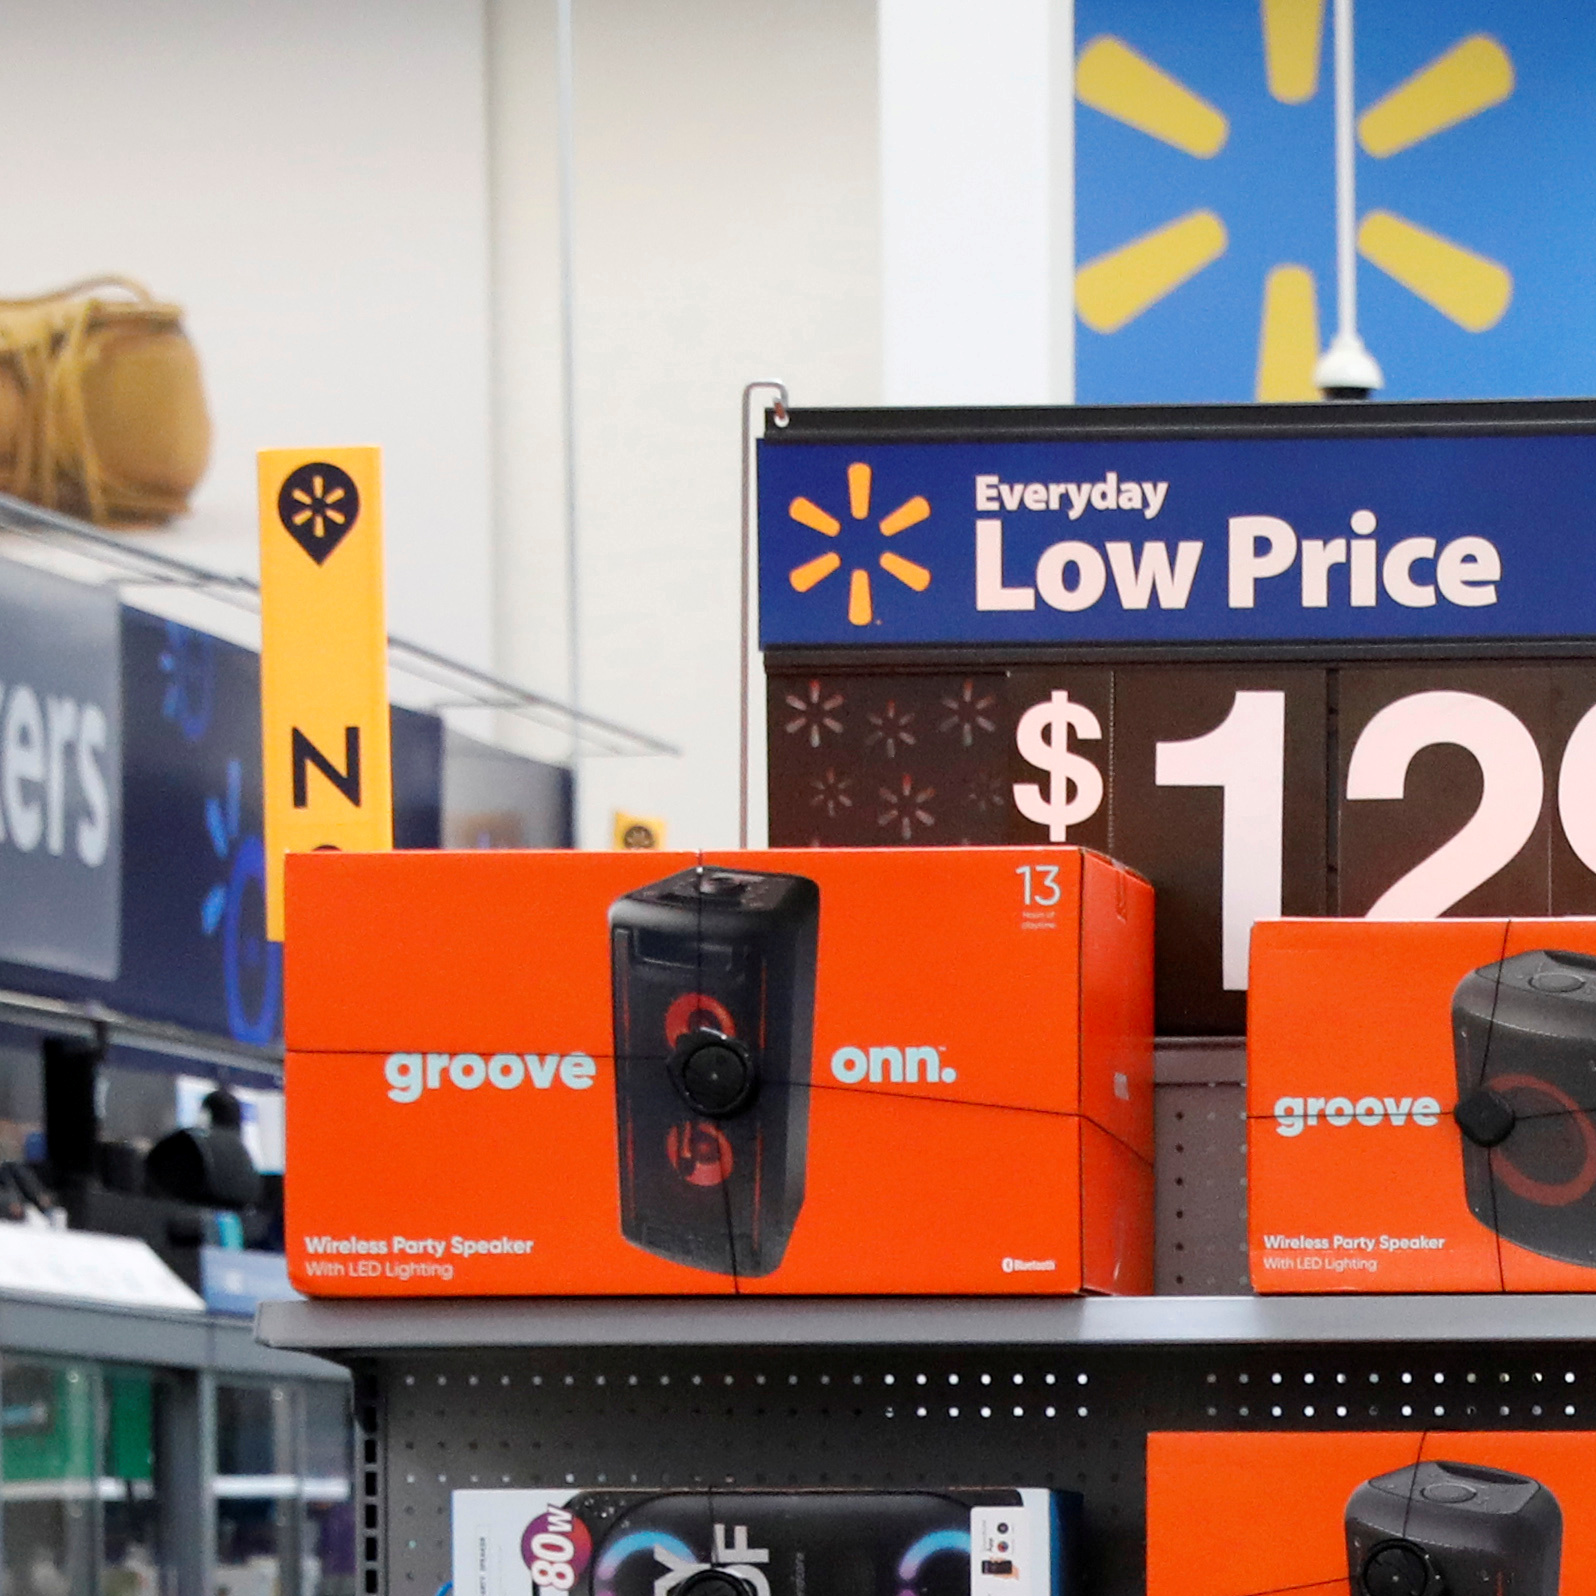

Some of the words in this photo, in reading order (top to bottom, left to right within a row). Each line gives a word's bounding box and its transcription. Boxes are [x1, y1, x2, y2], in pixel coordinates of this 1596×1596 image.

[975, 471, 1169, 520] Everyday
[975, 518, 1203, 612] Low
[1228, 509, 1502, 609] Price
[0, 684, 110, 868] ers
[292, 726, 361, 809] N
[1016, 865, 1062, 906] 13
[384, 1051, 597, 1104] groove
[831, 1046, 957, 1084] onn.
[1274, 1096, 1441, 1137] groove
[305, 1236, 388, 1255] Wireless
[393, 1237, 446, 1258] Party
[451, 1236, 534, 1258] Speaker
[1263, 1235, 1330, 1250] Wireless
[1333, 1235, 1376, 1252] Party
[1379, 1235, 1445, 1252] Speaker
[305, 1261, 345, 1278] With
[349, 1261, 381, 1278] LED
[385, 1261, 454, 1282] Lighting
[1263, 1257, 1294, 1270] With
[1297, 1257, 1322, 1270] LED
[1325, 1257, 1378, 1272] Lighting
